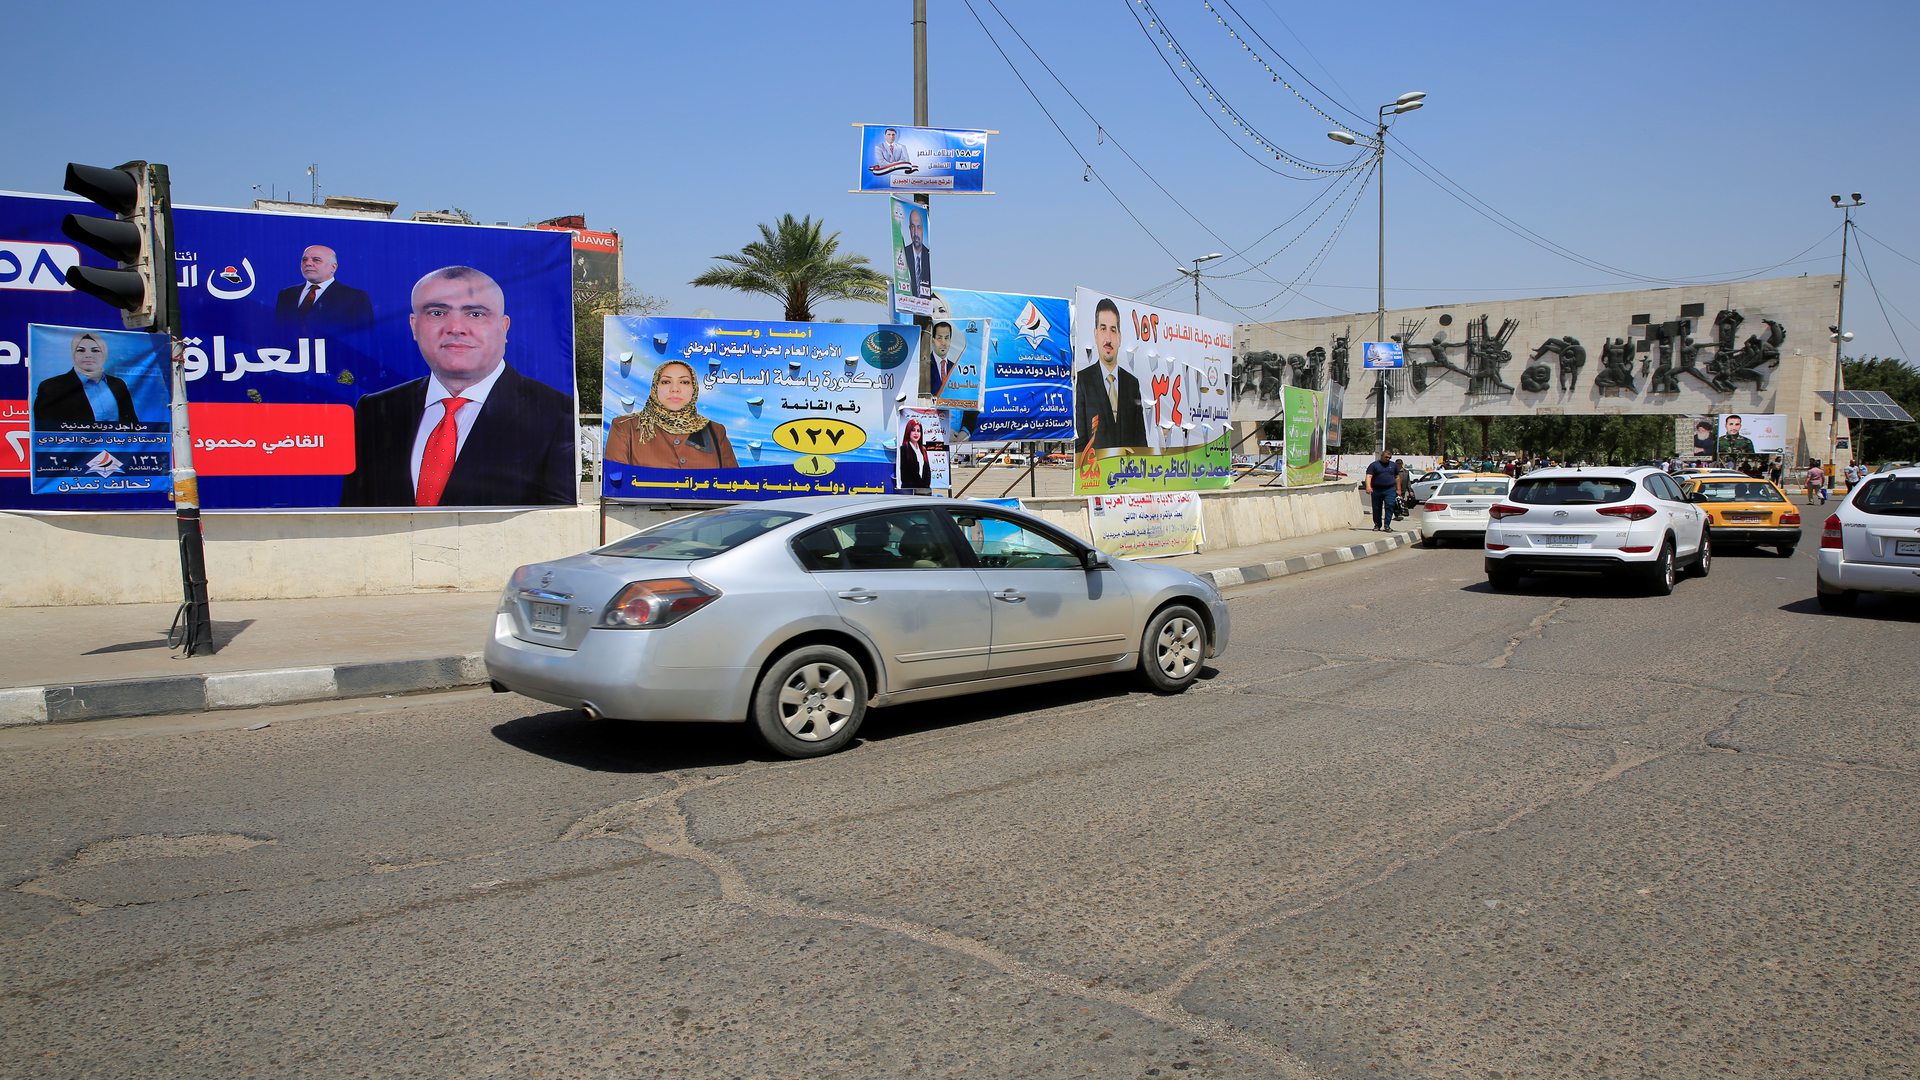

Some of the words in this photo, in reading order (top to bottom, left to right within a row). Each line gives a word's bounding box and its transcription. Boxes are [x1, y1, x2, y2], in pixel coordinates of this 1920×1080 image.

[769, 326, 812, 339] أملنا
[1131, 309, 1160, 344] ١٥٢
[1163, 322, 1193, 342] القانون
[715, 328, 760, 339] وعد
[1195, 328, 1213, 349] دولة
[683, 341, 716, 358] الوطني
[720, 342, 750, 358] اليقين
[752, 344, 782, 358] لحزب
[784, 346, 809, 360] العام
[812, 344, 842, 360] الأمين
[182, 335, 327, 382] العراق
[958, 365, 976, 375] ١٥٦
[996, 364, 1024, 376] مدنية
[1025, 366, 1044, 378] دولة
[1044, 365, 1060, 378] أجل
[1060, 369, 1070, 378] من
[704, 368, 770, 390] الساعدي
[773, 369, 820, 392] باسمة
[822, 370, 894, 392] الدكتورة
[781, 398, 832, 410] القائمة
[1003, 393, 1018, 404] ٦٠
[1044, 392, 1064, 404] ١٣٦
[1151, 374, 1182, 427] ٣٤
[836, 400, 861, 414] رقم
[1020, 406, 1030, 414] رقم
[1213, 406, 1228, 421] تسلسل
[60, 422, 91, 430] مدنية
[92, 422, 114, 431] دولة
[115, 422, 134, 431] أجل
[980, 421, 1010, 432] العوادي
[1030, 420, 1044, 430] بيان
[38, 436, 78, 446] العوادي
[106, 436, 126, 444] بيان
[789, 428, 845, 446] ١٢٧
[194, 438, 257, 451] محمود
[262, 435, 324, 454] القاضي
[50, 456, 68, 466] ٦٠
[132, 456, 158, 465] ١٣٦
[811, 456, 818, 472] ١
[103, 479, 150, 489] تحالف
[632, 475, 710, 491] عراقية
[713, 477, 760, 492] بهوية
[762, 478, 811, 493] مدنية
[814, 480, 846, 495] دولة
